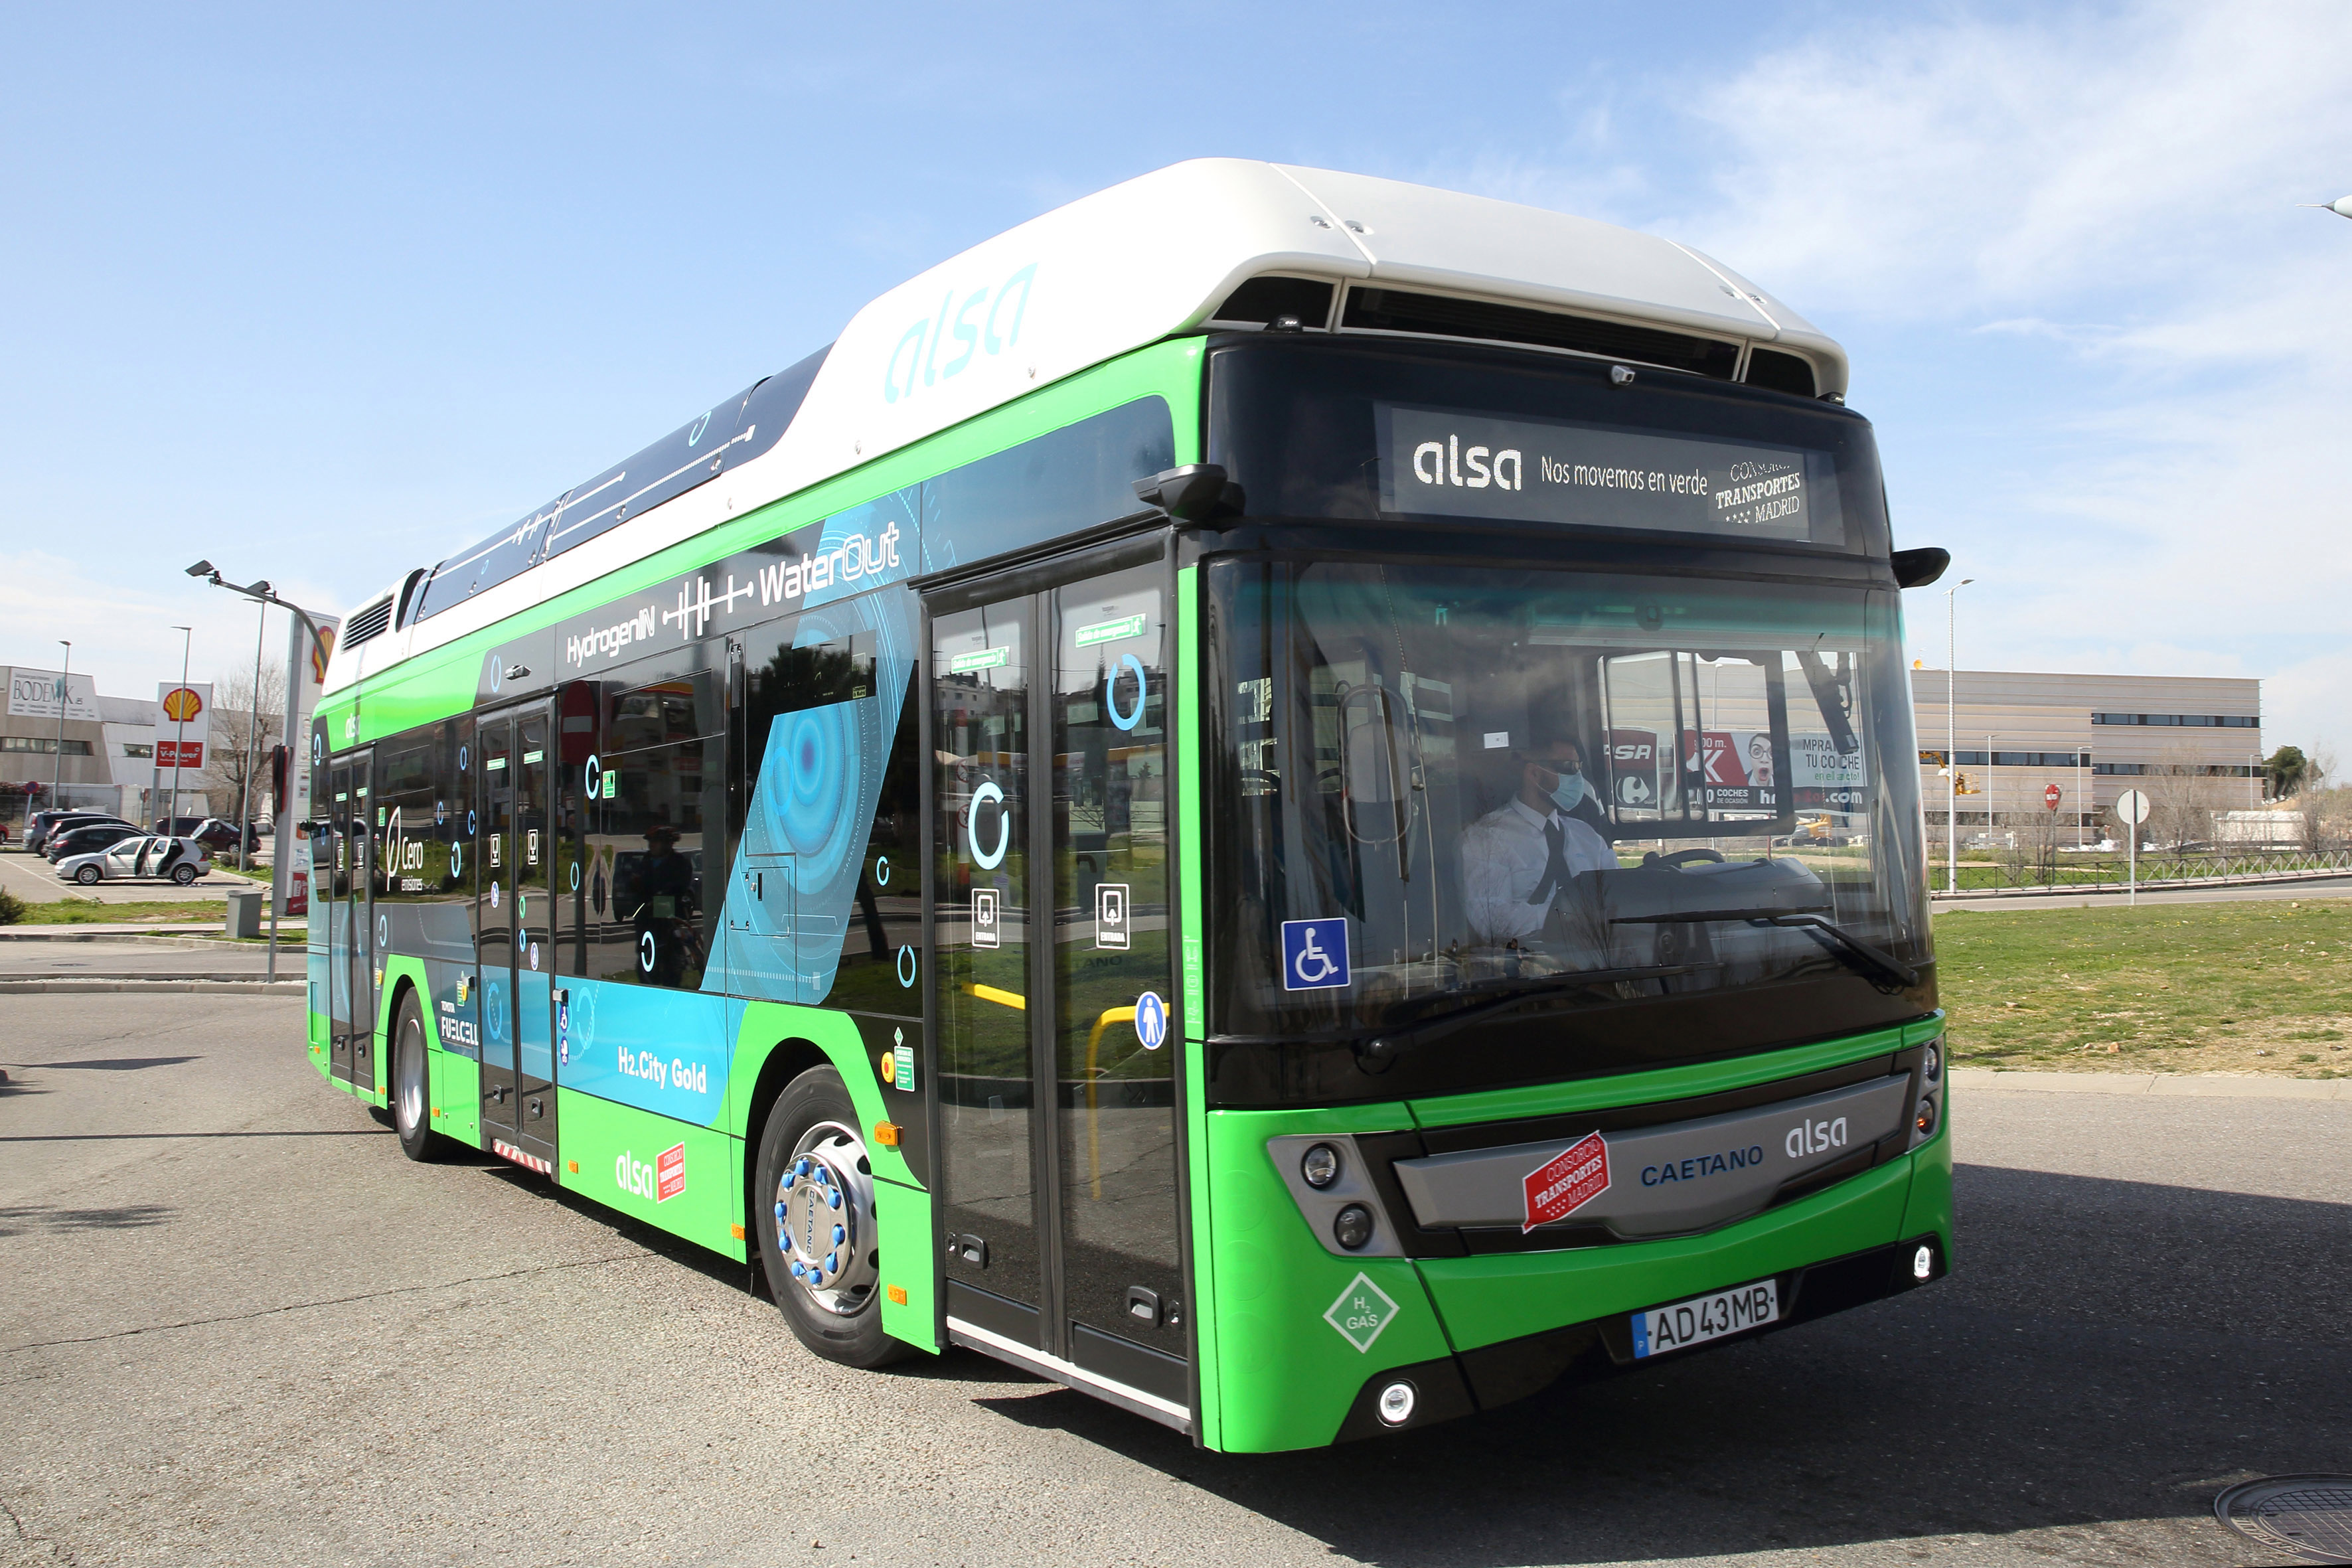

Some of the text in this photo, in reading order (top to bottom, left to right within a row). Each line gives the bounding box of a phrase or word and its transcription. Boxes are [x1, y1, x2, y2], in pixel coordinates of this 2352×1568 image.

[885, 262, 1038, 404] alsa
[1413, 434, 1708, 496] alsa Nos movemos en verde
[1716, 472, 1800, 509] TRANSPORTES
[1755, 496, 1800, 523] MADRID
[1806, 753, 1818, 768] TU
[1717, 789, 1749, 797] COCHES
[402, 836, 424, 870] Cero
[975, 931, 996, 941] ENTRADA
[1100, 931, 1126, 942] ENTRADA
[671, 1058, 707, 1094] Gold
[1785, 1117, 1847, 1158] alsa
[615, 1150, 653, 1200] alsa
[1547, 1139, 1601, 1182] CONSORCIO
[1640, 1145, 1764, 1187] CAETANO
[1535, 1155, 1603, 1209] TRANSPORTES
[1567, 1172, 1604, 1206] MADRID
[1346, 1314, 1378, 1330] GAS
